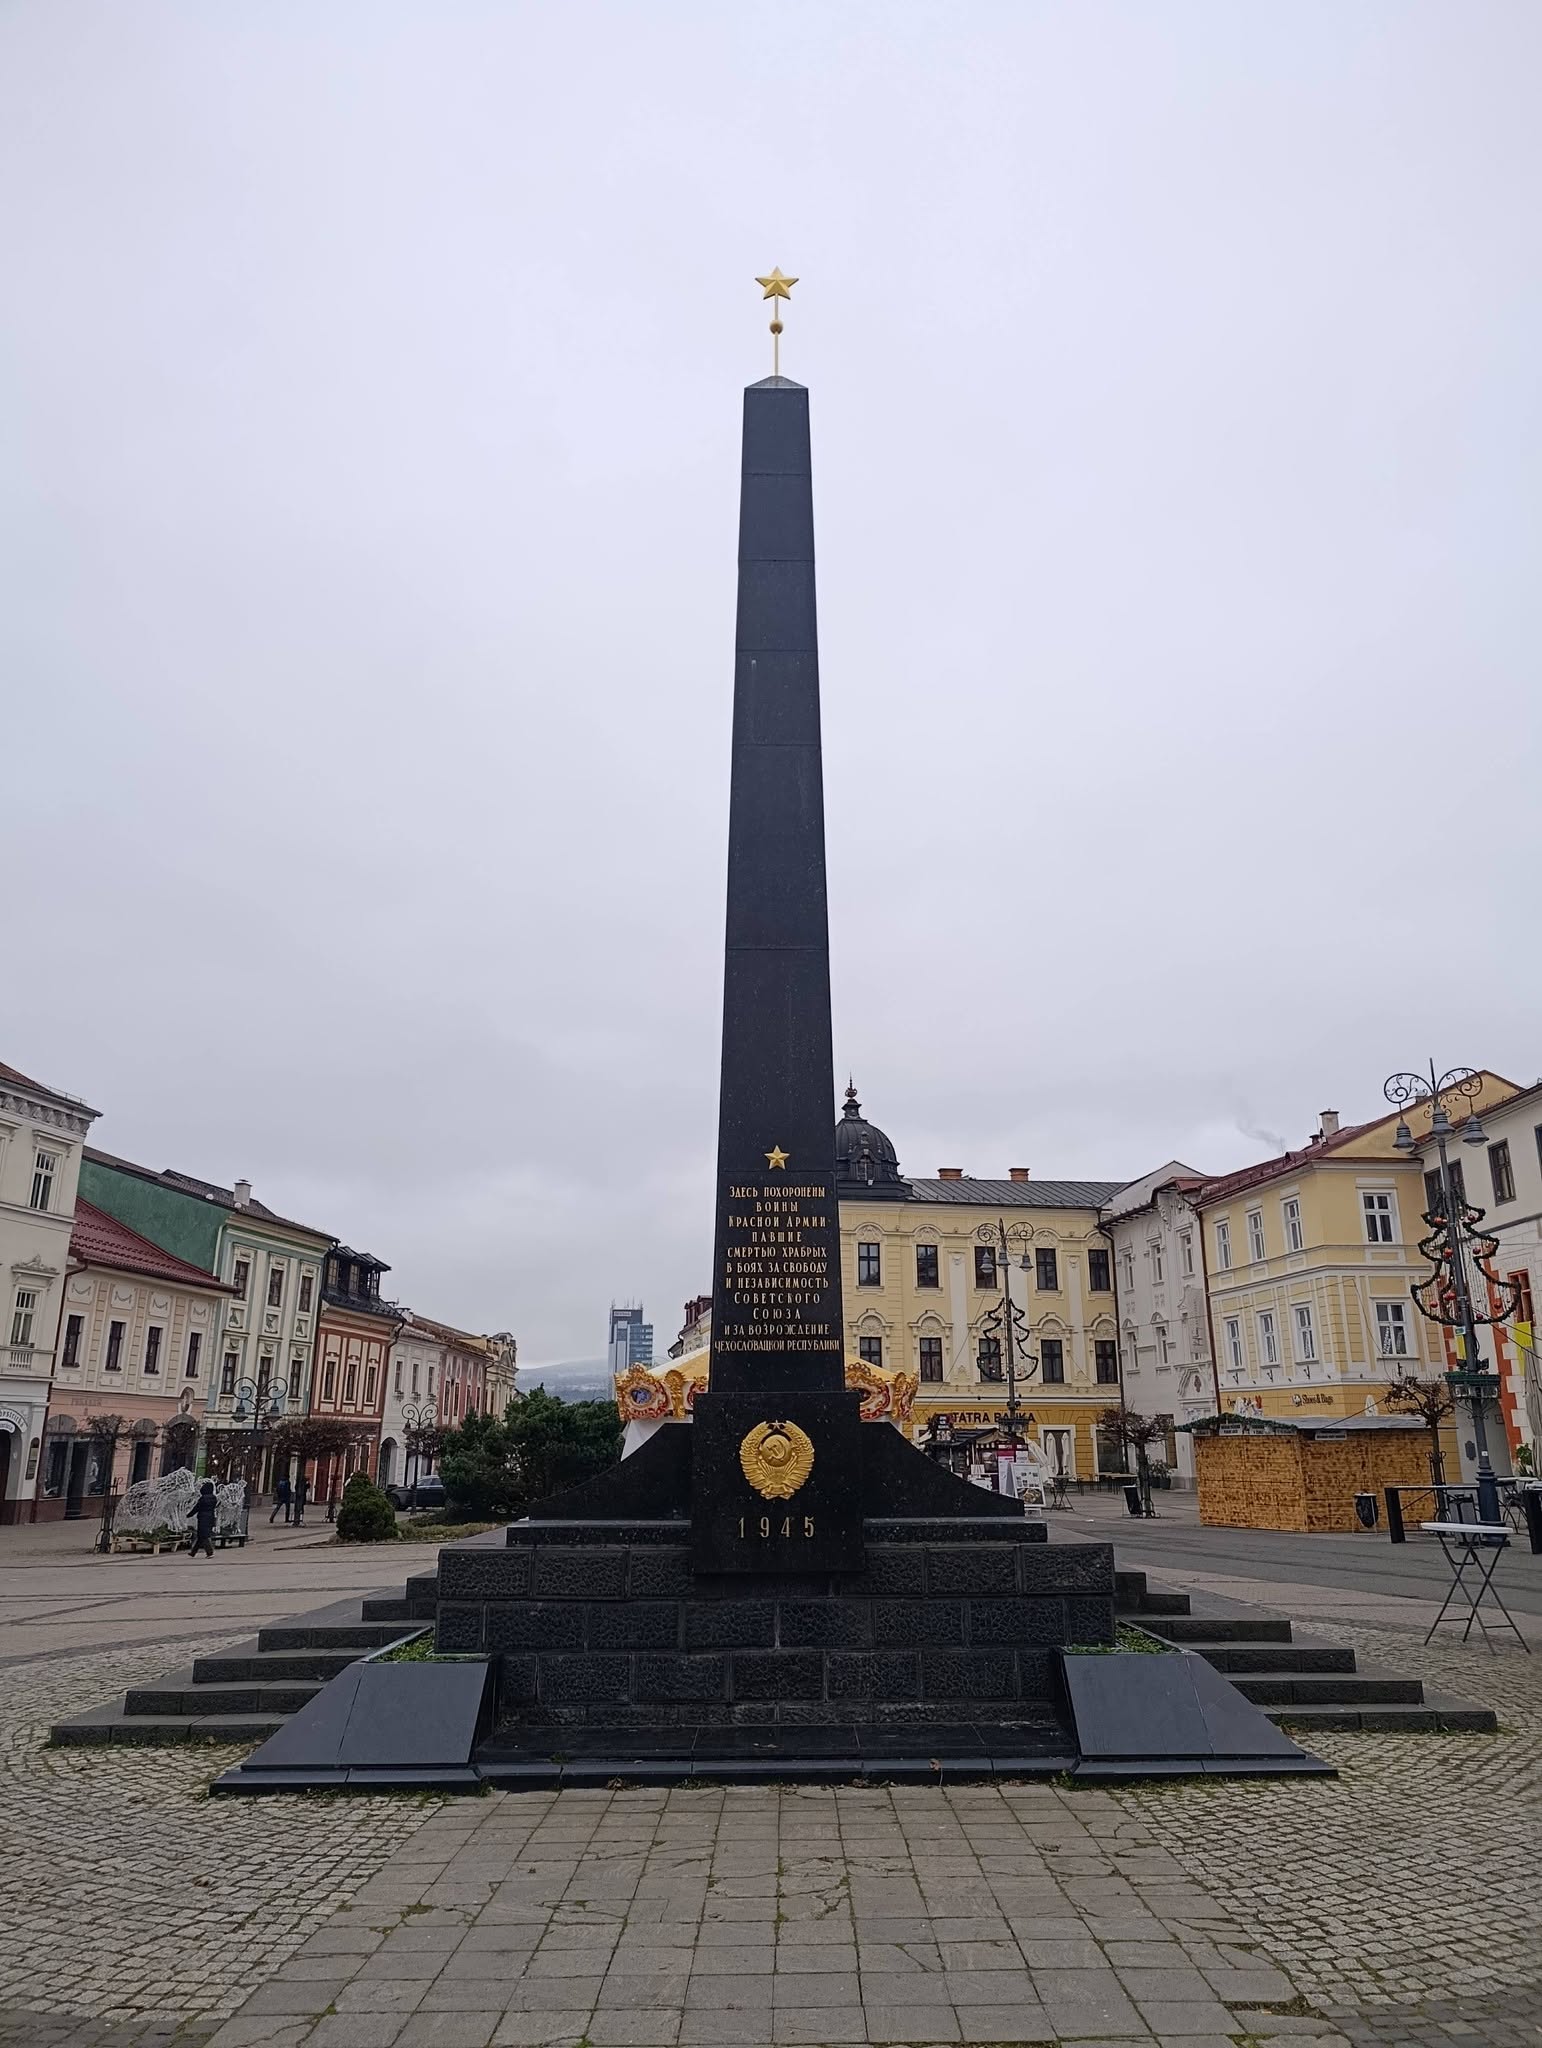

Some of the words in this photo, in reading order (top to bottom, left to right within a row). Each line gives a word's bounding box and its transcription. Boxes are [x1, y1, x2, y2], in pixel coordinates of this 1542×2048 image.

[729, 1186, 758, 1198] ЗДЕСЬ
[763, 1187, 825, 1198] ПОХОРОНЕНЫ
[756, 1201, 798, 1212] ВОИНЫ
[786, 1216, 826, 1227] АРМИИ
[752, 1232, 802, 1242] ПАВШИЕ
[727, 1247, 776, 1258] СМЕРТЬЮ
[782, 1247, 827, 1258] ХРАБРЫХ
[726, 1262, 732, 1273] В
[737, 1262, 763, 1273] БОЯХ
[768, 1262, 780, 1273] ЗА
[783, 1262, 827, 1273] СВОБОДУ
[726, 1278, 732, 1289] И
[738, 1278, 829, 1289] НЕЗАВИСИМОСТЬ
[734, 1292, 820, 1304] СОВЕТСКОГО
[753, 1307, 801, 1319] СОЮЗА
[748, 1324, 830, 1335] ВОЗРОЖДЕНИЕ
[787, 1340, 840, 1351] РЕСПУБЛИКИ
[952, 1412, 991, 1423] TATRA
[737, 1516, 816, 1539] 1945
